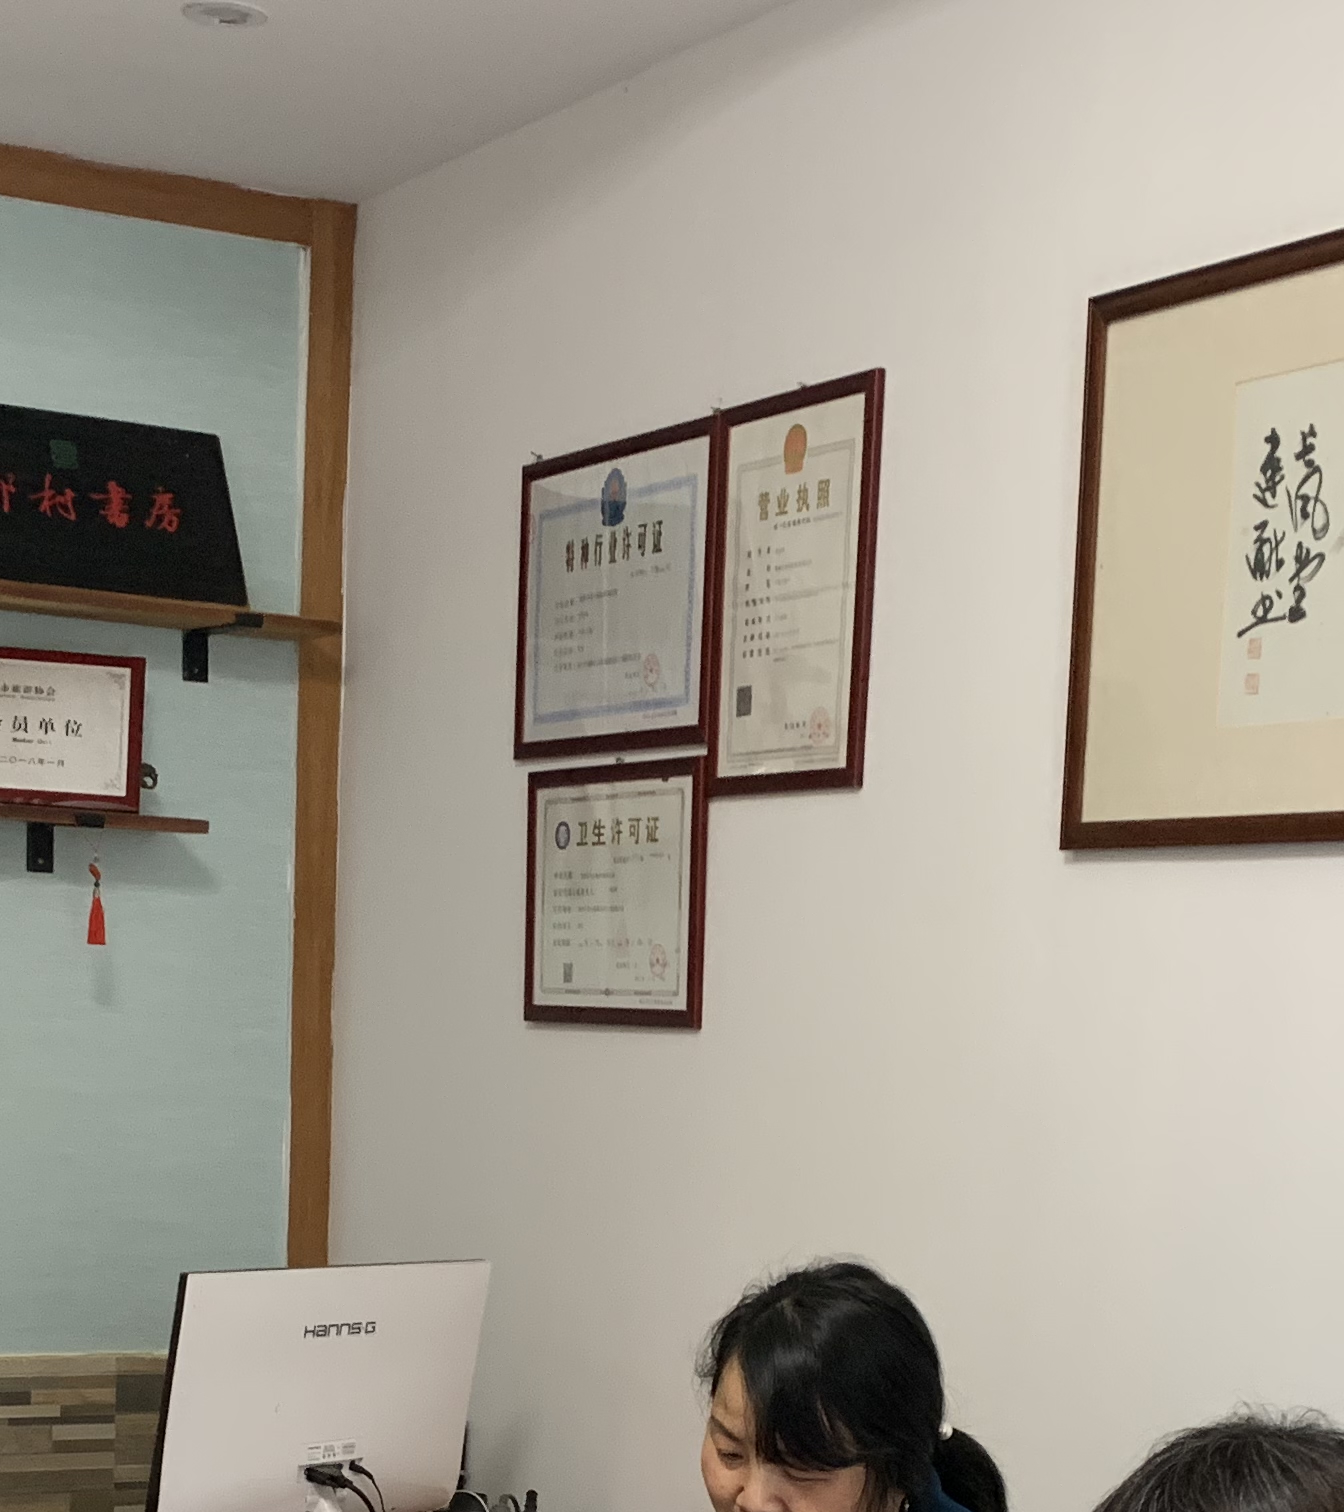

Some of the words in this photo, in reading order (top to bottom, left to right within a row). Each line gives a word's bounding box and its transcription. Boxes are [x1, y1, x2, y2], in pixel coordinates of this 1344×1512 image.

[758, 478, 831, 521] 营业执照
[565, 519, 664, 574] 特种行业许可证
[576, 816, 660, 847] 卫生许可证
